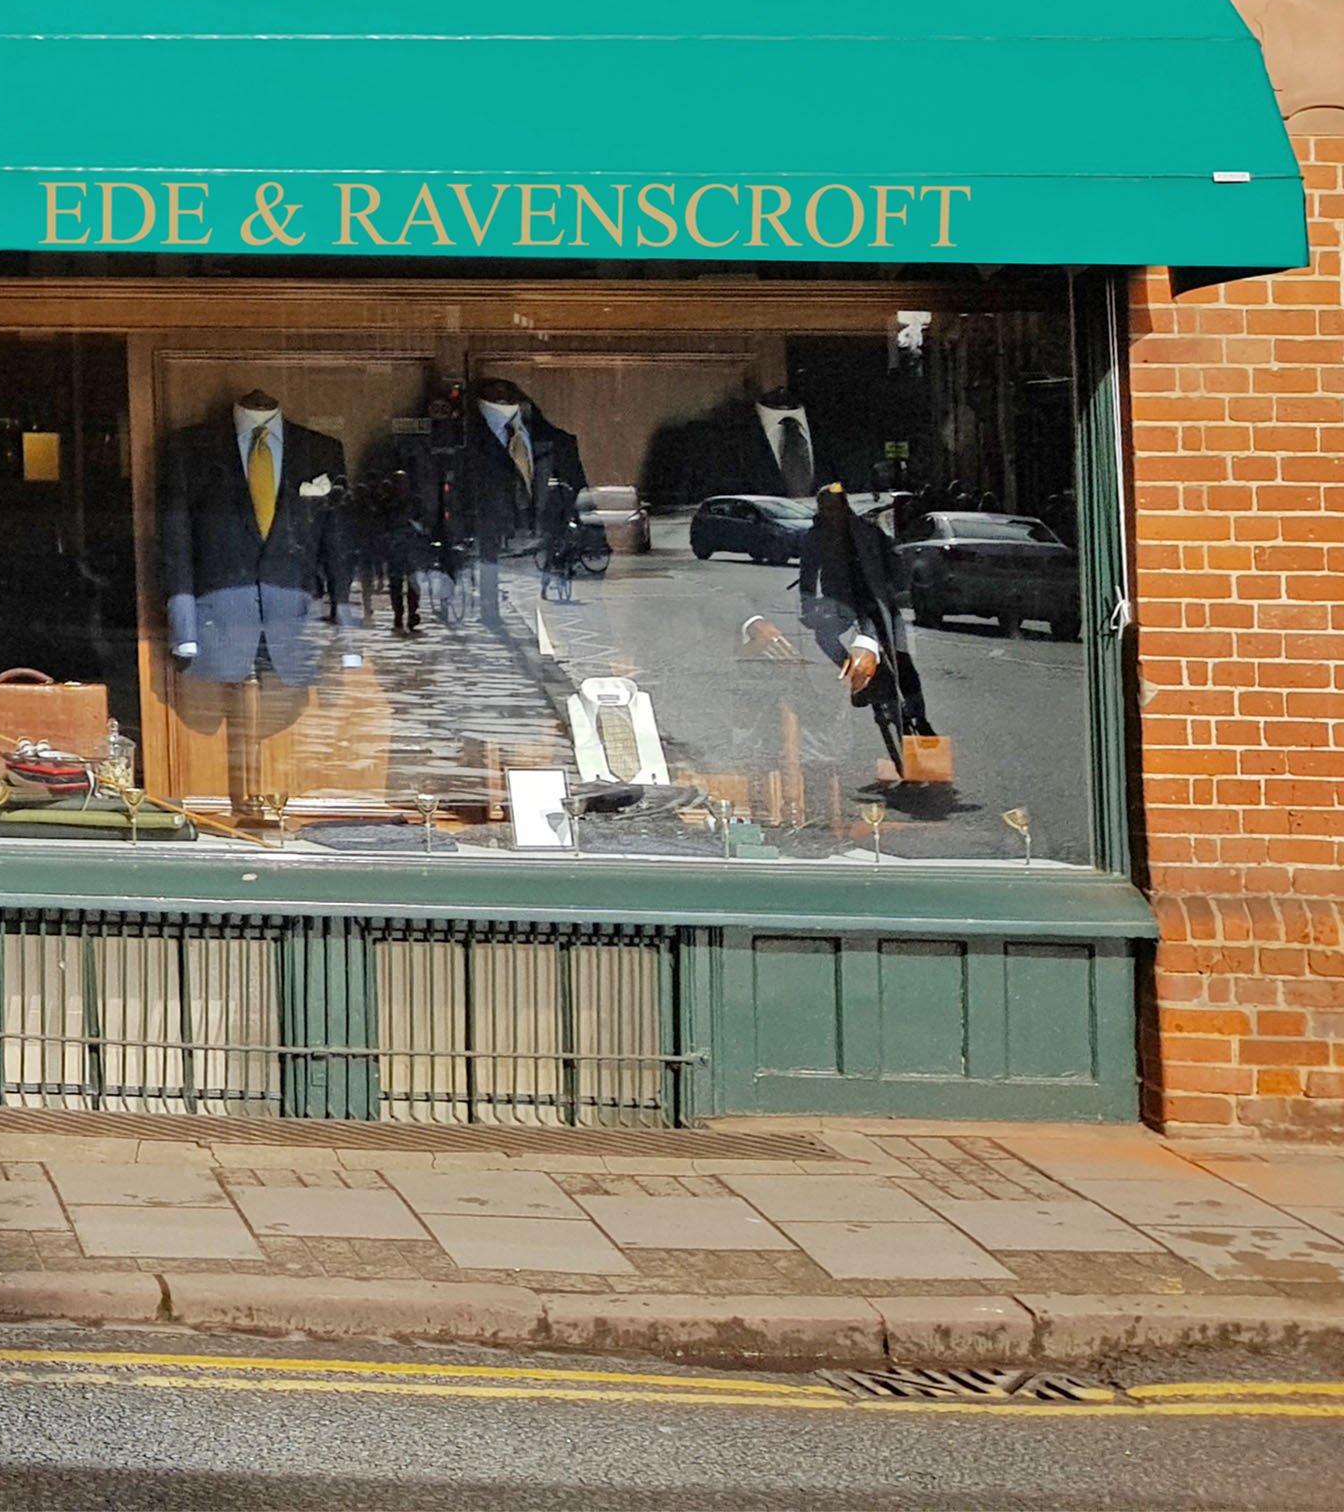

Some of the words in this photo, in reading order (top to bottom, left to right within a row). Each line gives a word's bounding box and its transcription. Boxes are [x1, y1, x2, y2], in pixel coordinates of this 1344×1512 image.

[39, 182, 213, 245] EDE
[240, 181, 306, 246] &
[332, 183, 972, 248] RAVENSCROFT
